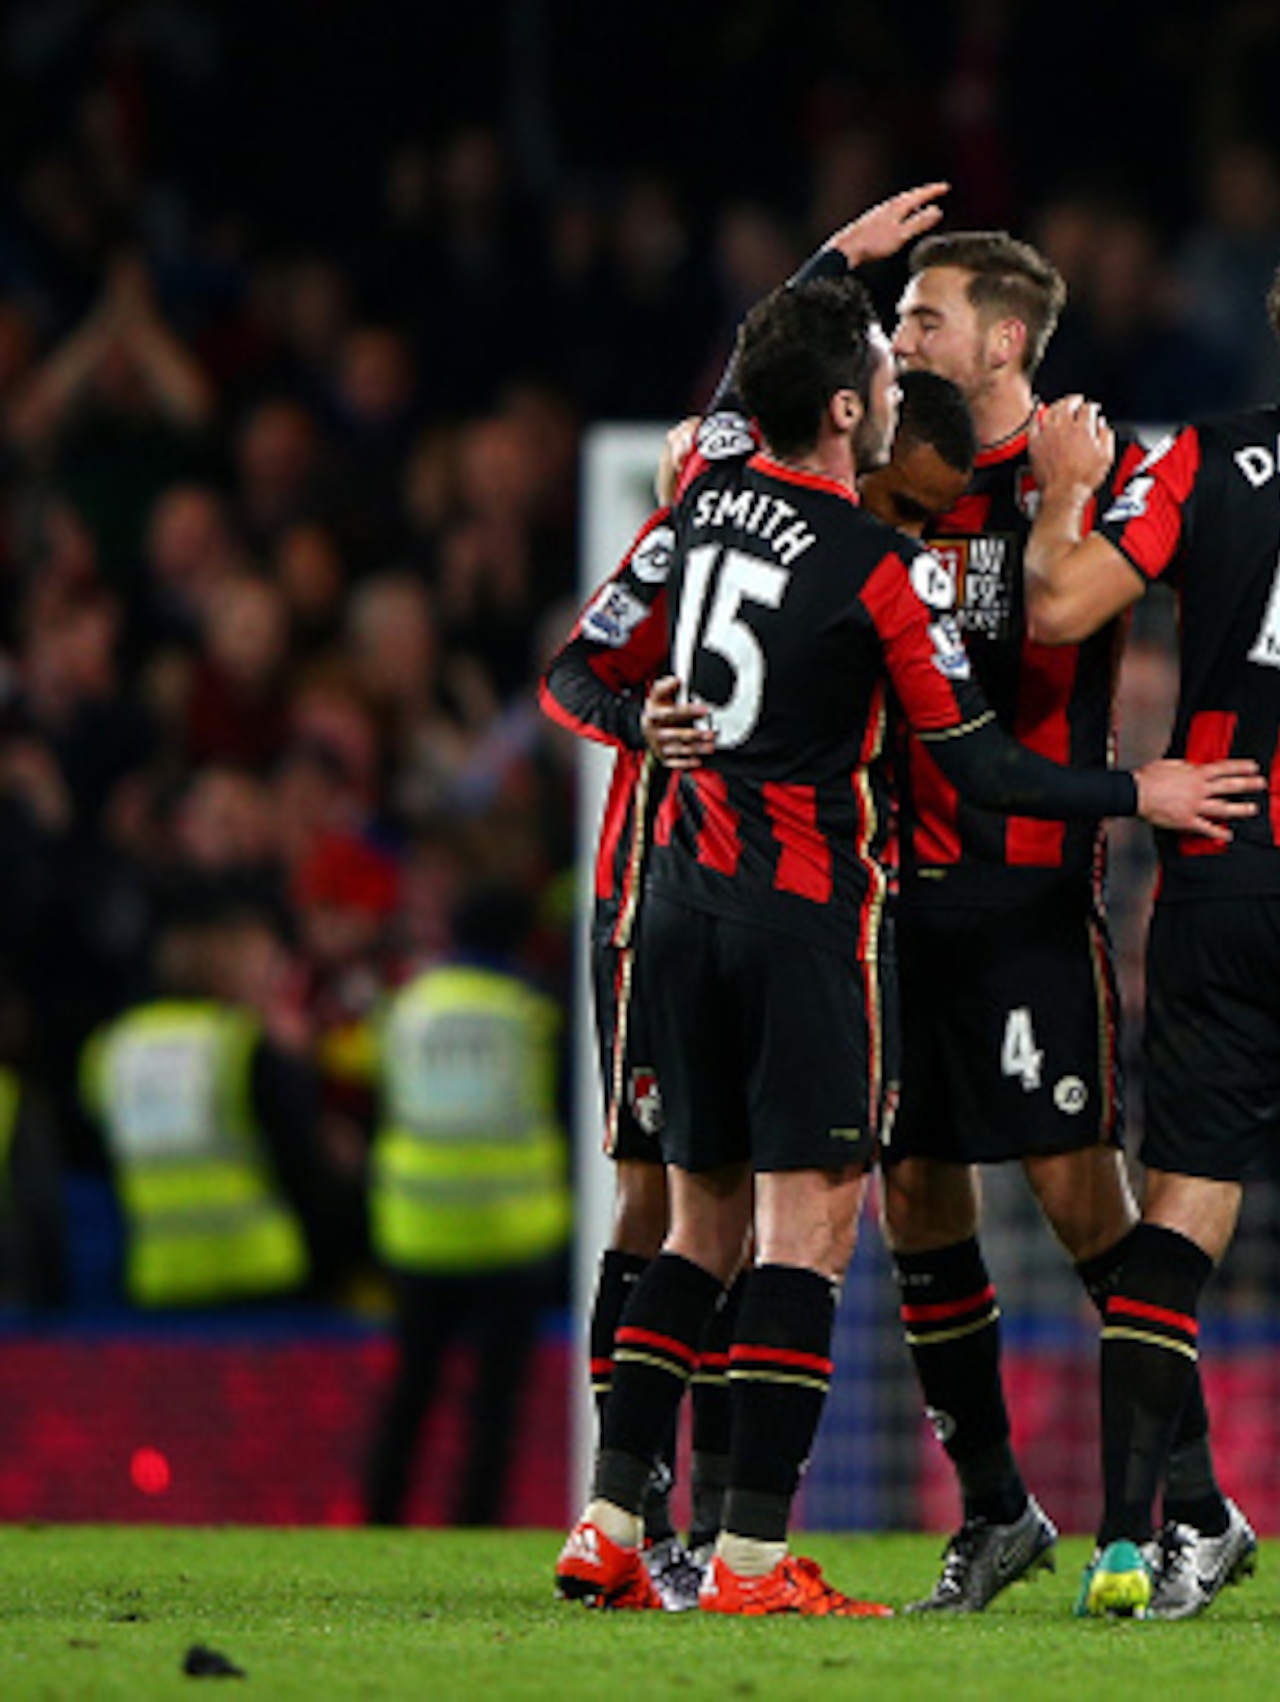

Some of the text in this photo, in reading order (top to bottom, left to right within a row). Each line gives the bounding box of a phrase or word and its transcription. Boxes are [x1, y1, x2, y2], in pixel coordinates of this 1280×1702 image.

[694, 489, 817, 564] SMITH
[673, 542, 791, 750] 15
[1002, 1007, 1044, 1091] 4
